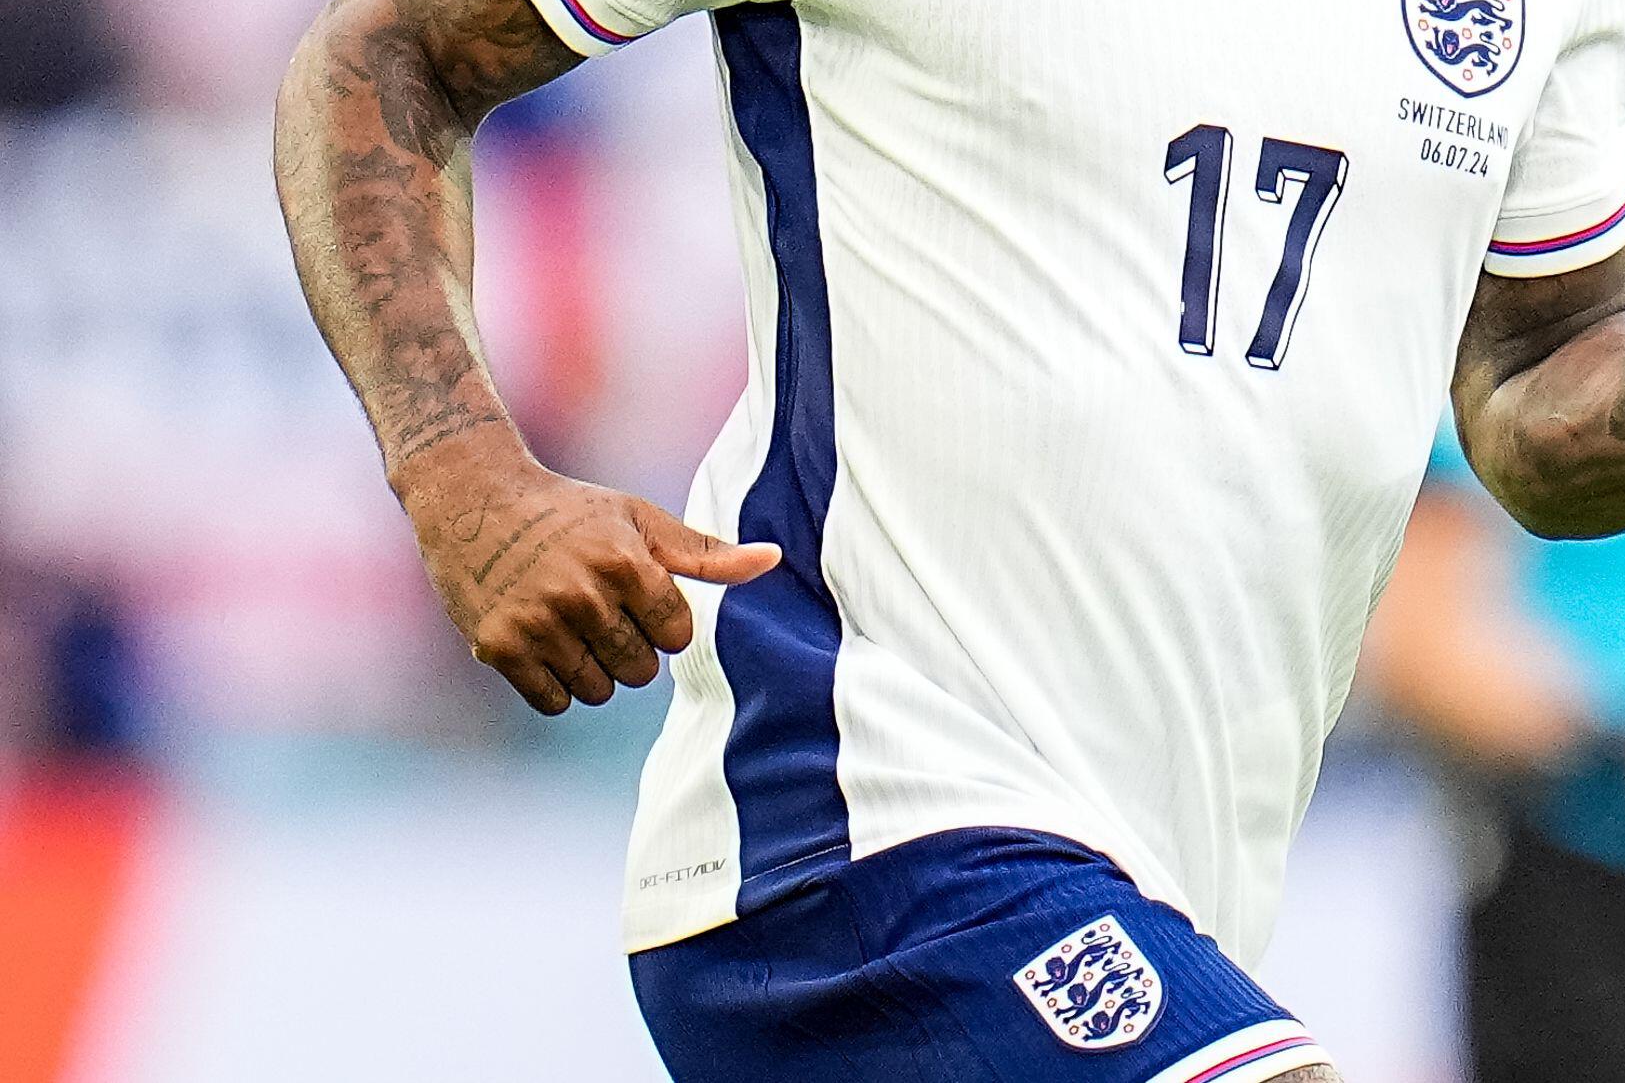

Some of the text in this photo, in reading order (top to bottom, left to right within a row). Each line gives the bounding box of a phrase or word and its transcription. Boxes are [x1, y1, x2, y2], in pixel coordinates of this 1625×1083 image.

[1398, 98, 1508, 149] SWITZERLAND
[1421, 138, 1489, 177] 06.07.24
[1164, 124, 1349, 370] 17
